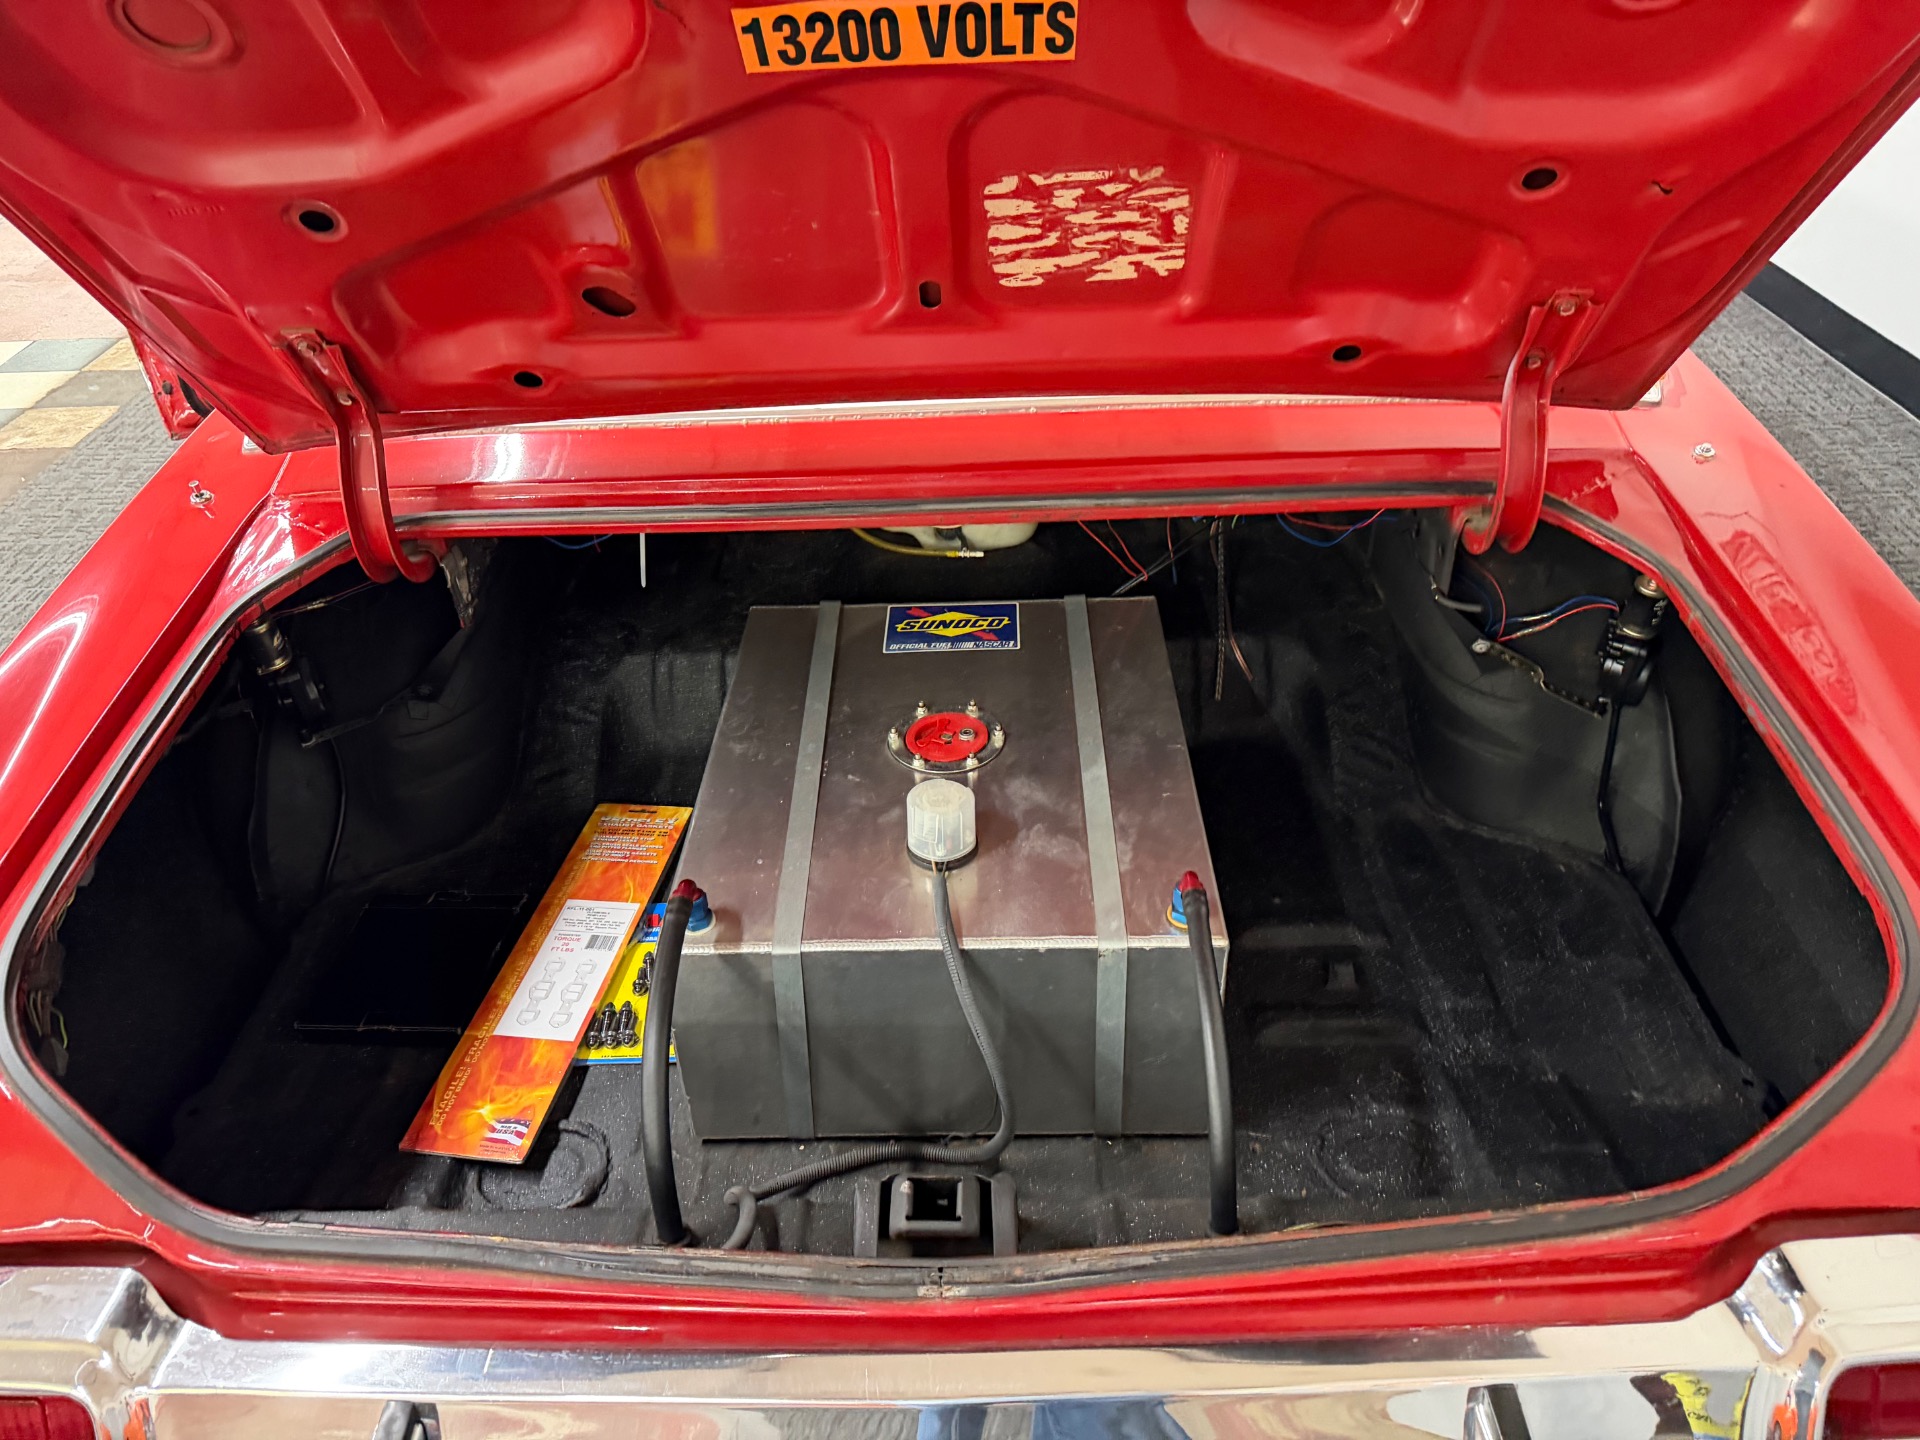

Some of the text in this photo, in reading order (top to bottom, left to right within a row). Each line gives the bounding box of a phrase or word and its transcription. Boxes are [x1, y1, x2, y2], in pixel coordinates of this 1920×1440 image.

[741, 1, 1076, 67] 13200 VOLTS
[901, 618, 1000, 631] SUNOCO
[889, 642, 928, 650] OFFICIAL
[553, 935, 582, 943] TORQUE
[429, 1066, 467, 1125] FRAGILE!
[465, 1008, 498, 1063] FRAGILE!
[437, 1113, 447, 1126] DO
[444, 1094, 457, 1112] NOT
